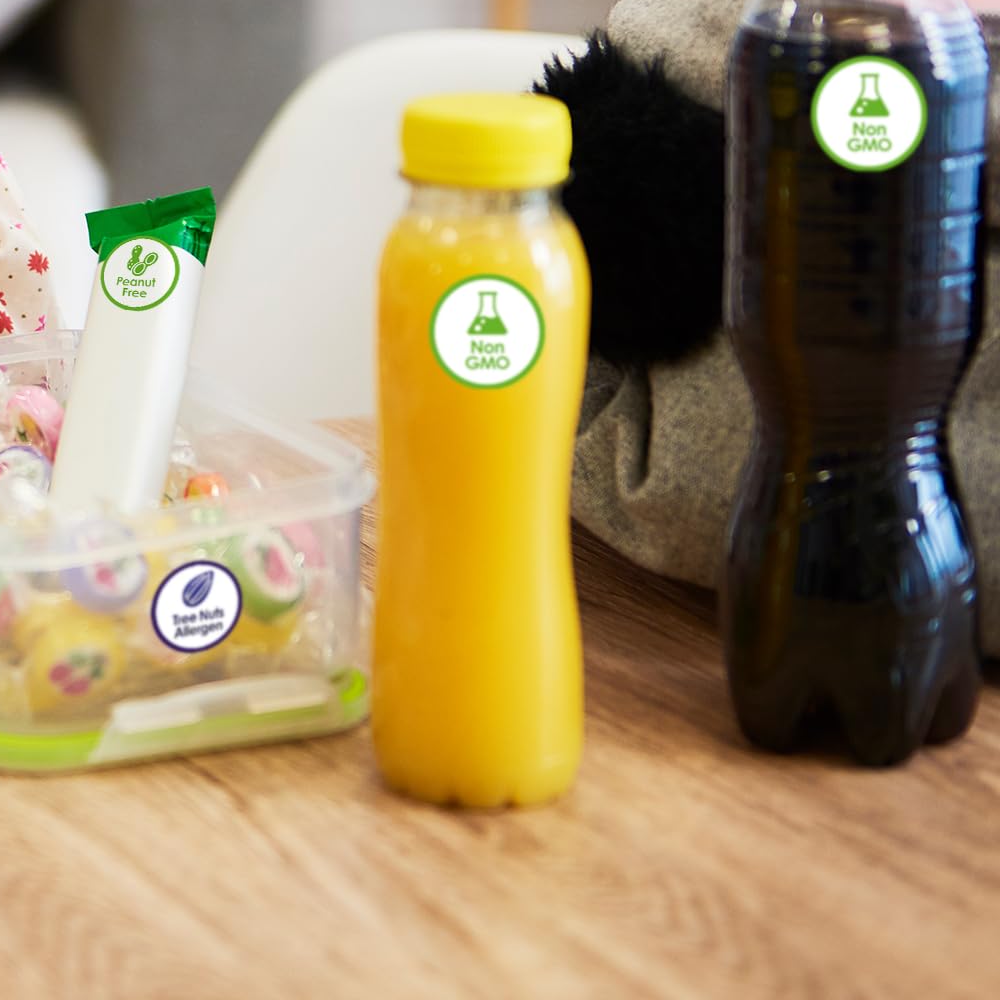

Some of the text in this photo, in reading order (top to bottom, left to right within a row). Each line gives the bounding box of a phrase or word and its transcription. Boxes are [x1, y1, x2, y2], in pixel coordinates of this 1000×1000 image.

[853, 123, 887, 136] Non
[847, 138, 892, 152] GMO
[116, 276, 156, 289] Peanut
[121, 287, 147, 299] Free
[471, 340, 505, 354] Non
[465, 355, 510, 370] GMO
[172, 607, 224, 626] Tree Nuts
[174, 620, 224, 639] Allergen
